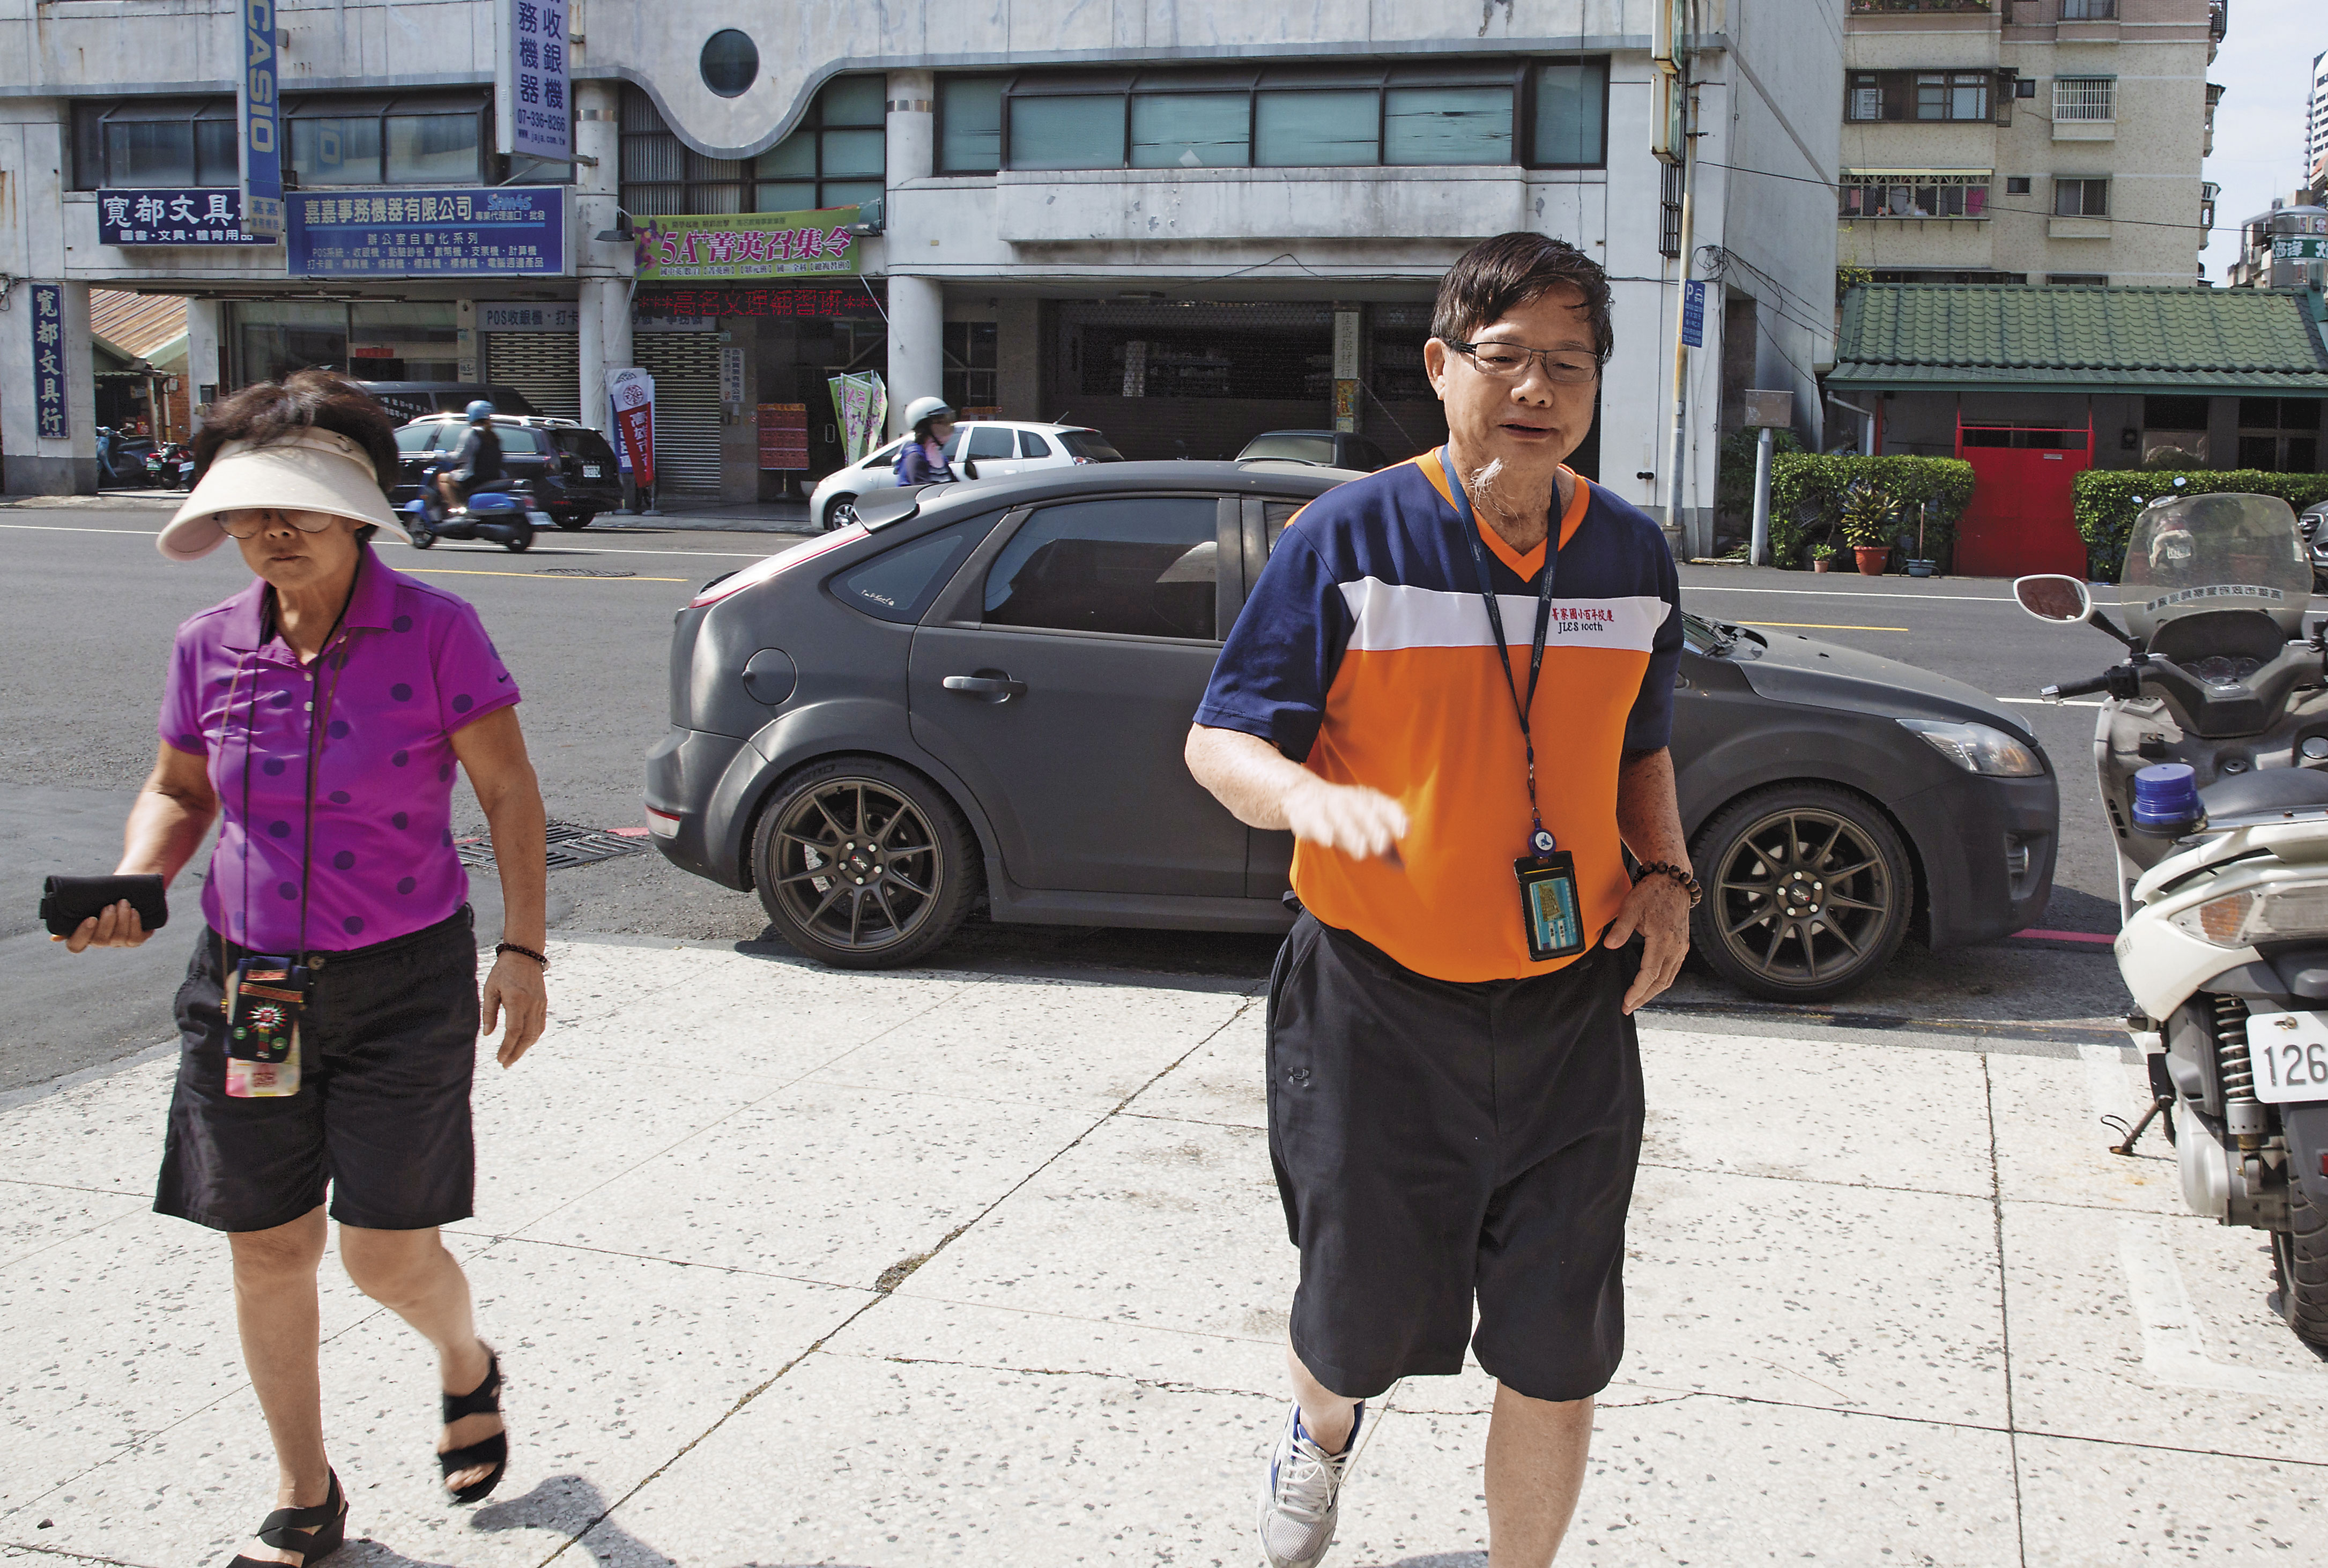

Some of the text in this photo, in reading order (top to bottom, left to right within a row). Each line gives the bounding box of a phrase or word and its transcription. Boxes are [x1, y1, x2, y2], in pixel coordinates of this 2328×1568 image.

[542, 0, 562, 110] 收銀機
[247, 0, 275, 153] CASIO
[517, 108, 565, 132] 07-336-8266
[517, 128, 565, 146] www.jaja.com.tw
[103, 194, 241, 228] 寬都文具
[305, 196, 472, 224] 嘉嘉事務機器有限公司
[367, 232, 479, 246] 辦公室自動化系列
[1686, 283, 1694, 301] P
[1581, 621, 1603, 631] 100th
